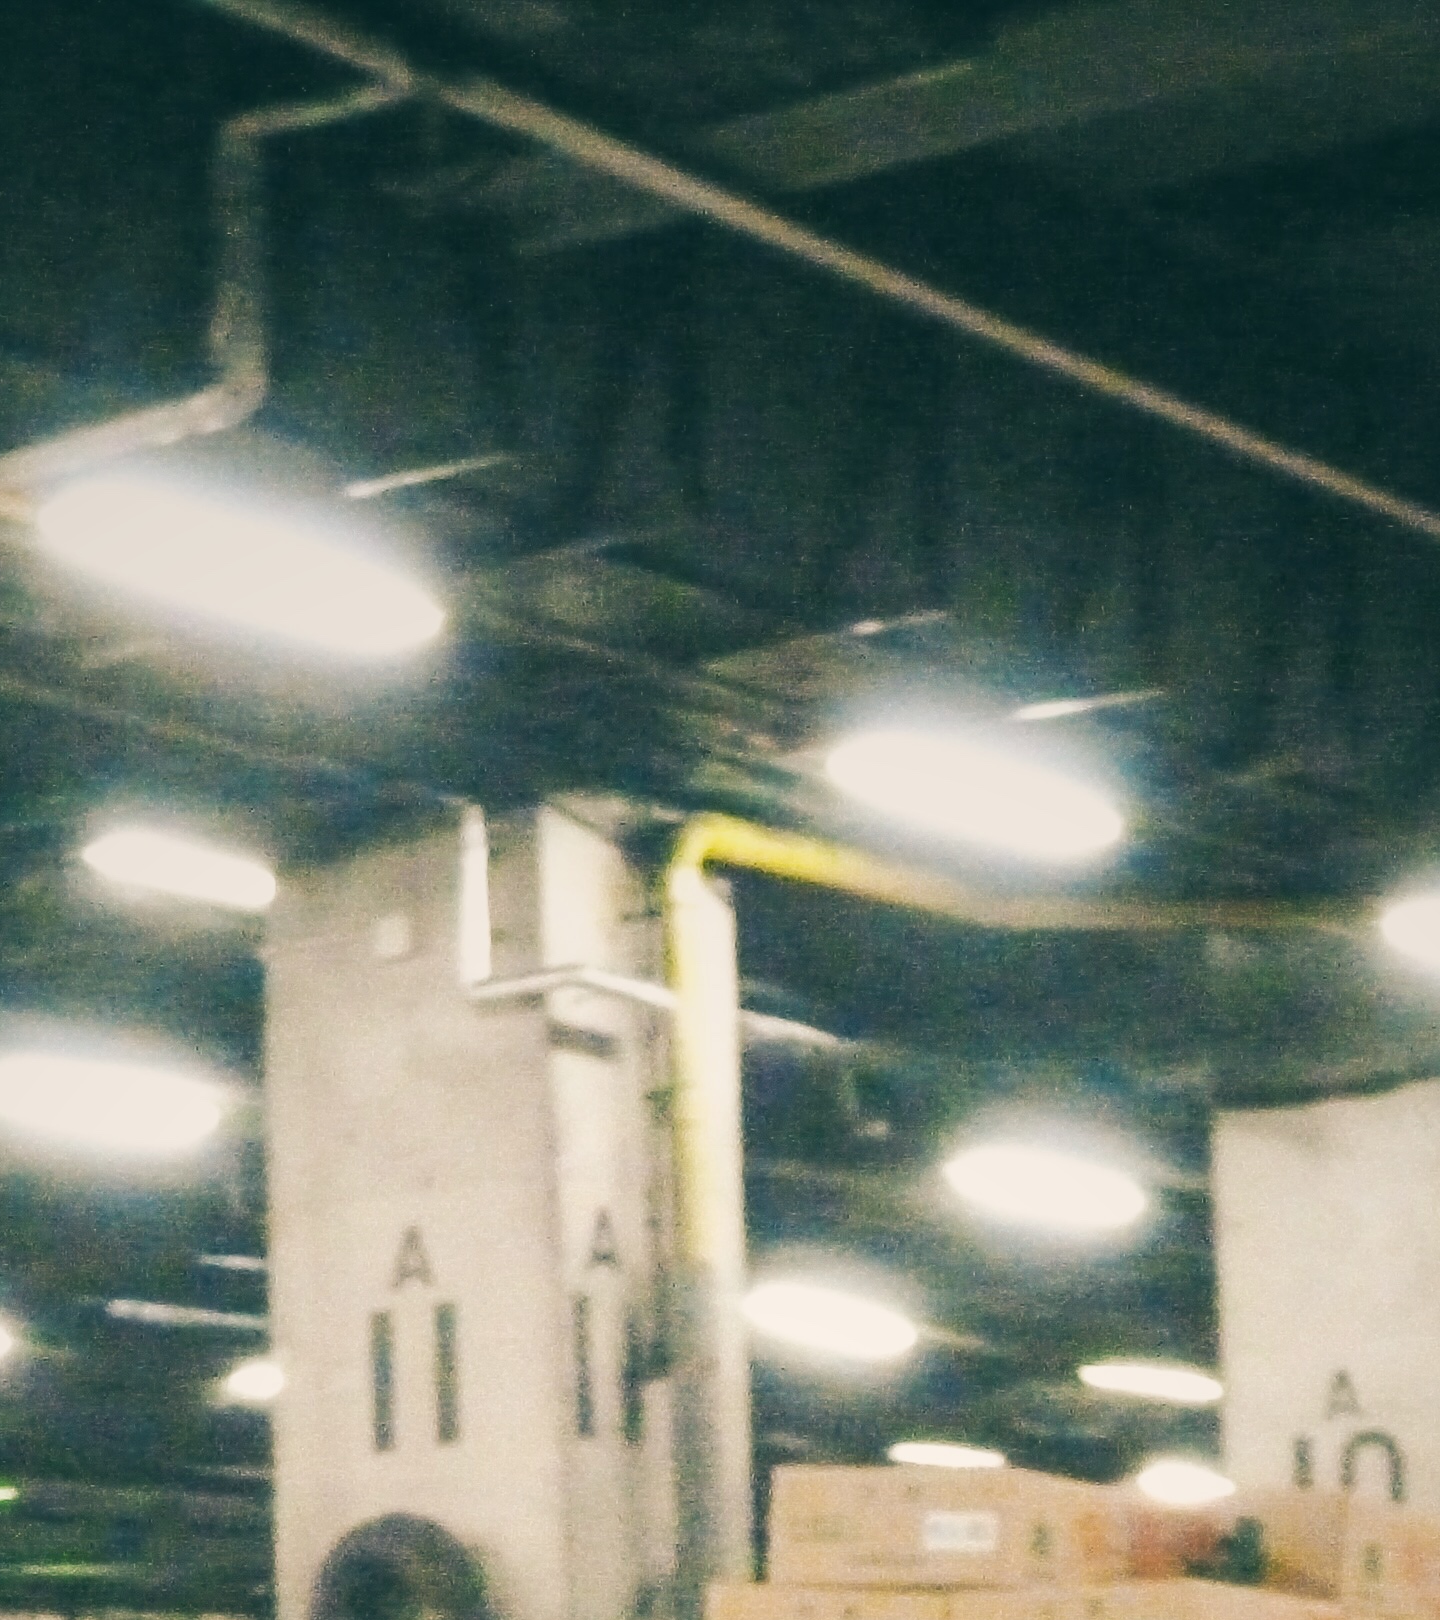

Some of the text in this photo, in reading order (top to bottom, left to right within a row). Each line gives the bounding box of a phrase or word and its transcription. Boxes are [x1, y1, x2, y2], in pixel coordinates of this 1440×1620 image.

[390, 1224, 437, 1289] A
[586, 1208, 620, 1270] A
[371, 1302, 459, 1452] 11
